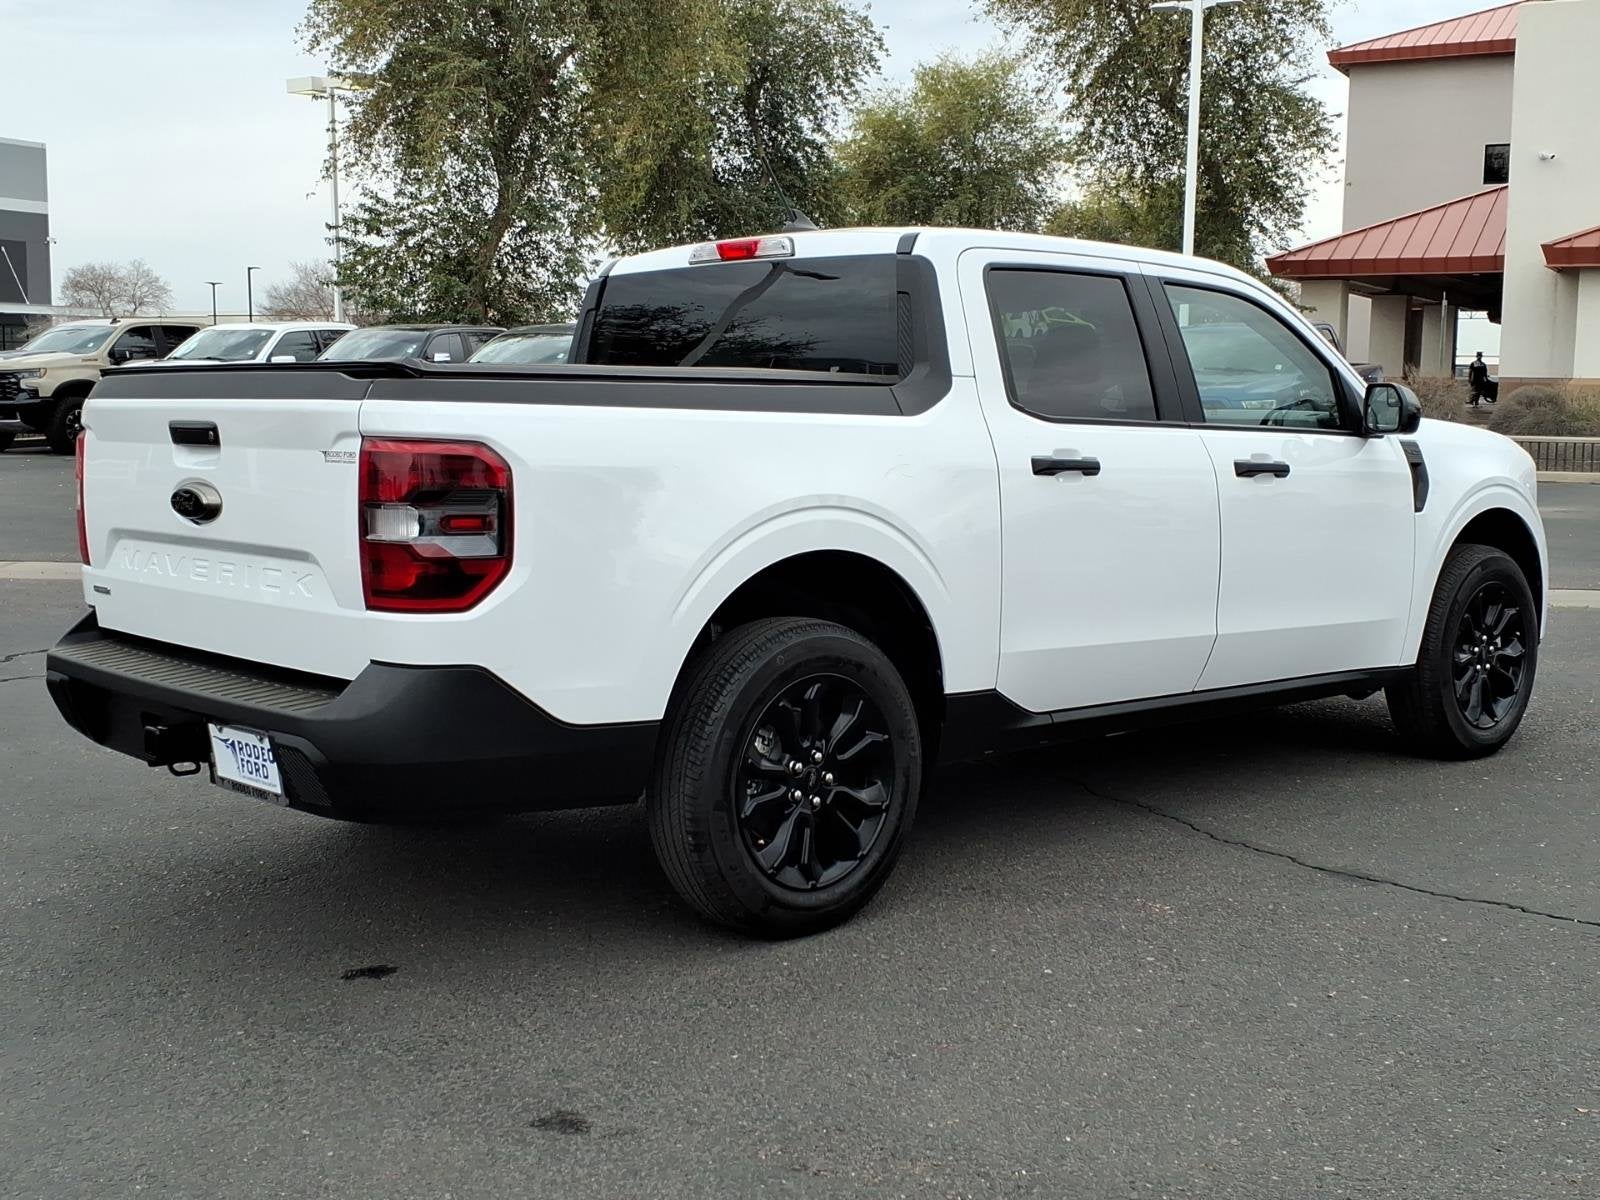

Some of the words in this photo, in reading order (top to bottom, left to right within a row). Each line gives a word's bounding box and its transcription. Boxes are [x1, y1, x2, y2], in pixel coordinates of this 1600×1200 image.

[120, 547, 314, 598] MAVERICK
[237, 740, 276, 764] RODEO
[241, 759, 269, 780] FORD
